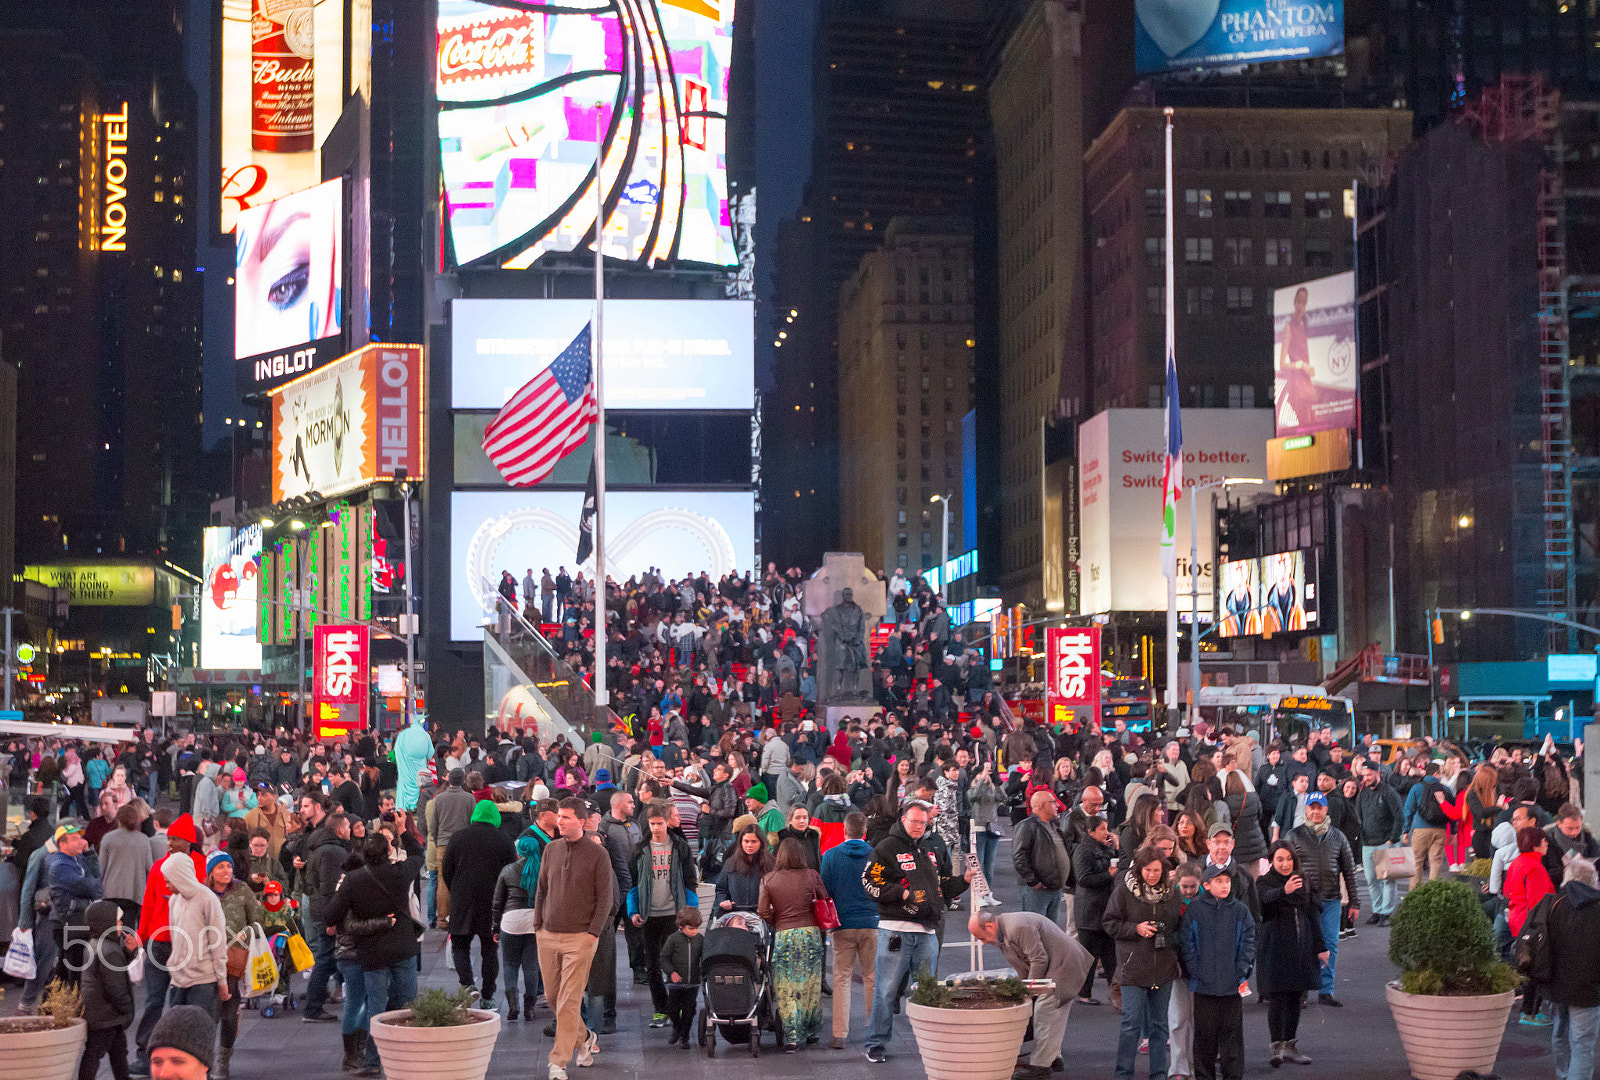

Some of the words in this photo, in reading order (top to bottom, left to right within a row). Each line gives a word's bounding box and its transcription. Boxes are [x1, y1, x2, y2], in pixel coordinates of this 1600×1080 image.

[1221, 3, 1335, 32] PHANTOM
[1228, 31, 1247, 44] OF
[1250, 28, 1279, 42] THE
[1279, 24, 1327, 39] OPERA
[101, 101, 128, 251] NOVOTEL
[255, 347, 316, 381] INGLOT
[1332, 356, 1348, 370] NY
[382, 351, 408, 473] HELLO!
[305, 409, 351, 448] MORMON
[1122, 450, 1165, 463] Switc
[1182, 452, 1195, 463] to
[1199, 450, 1250, 463] better.
[1122, 475, 1165, 488] Switc
[1182, 477, 1195, 488] to
[340, 513, 350, 560] OLIVE
[50, 572, 77, 581] WHAT
[80, 572, 97, 581] ARE
[80, 581, 109, 589] DOING
[79, 590, 114, 599] THERE?
[327, 630, 360, 697] tkts
[1060, 633, 1093, 698] tkts
[1114, 706, 1130, 716] LOOP
